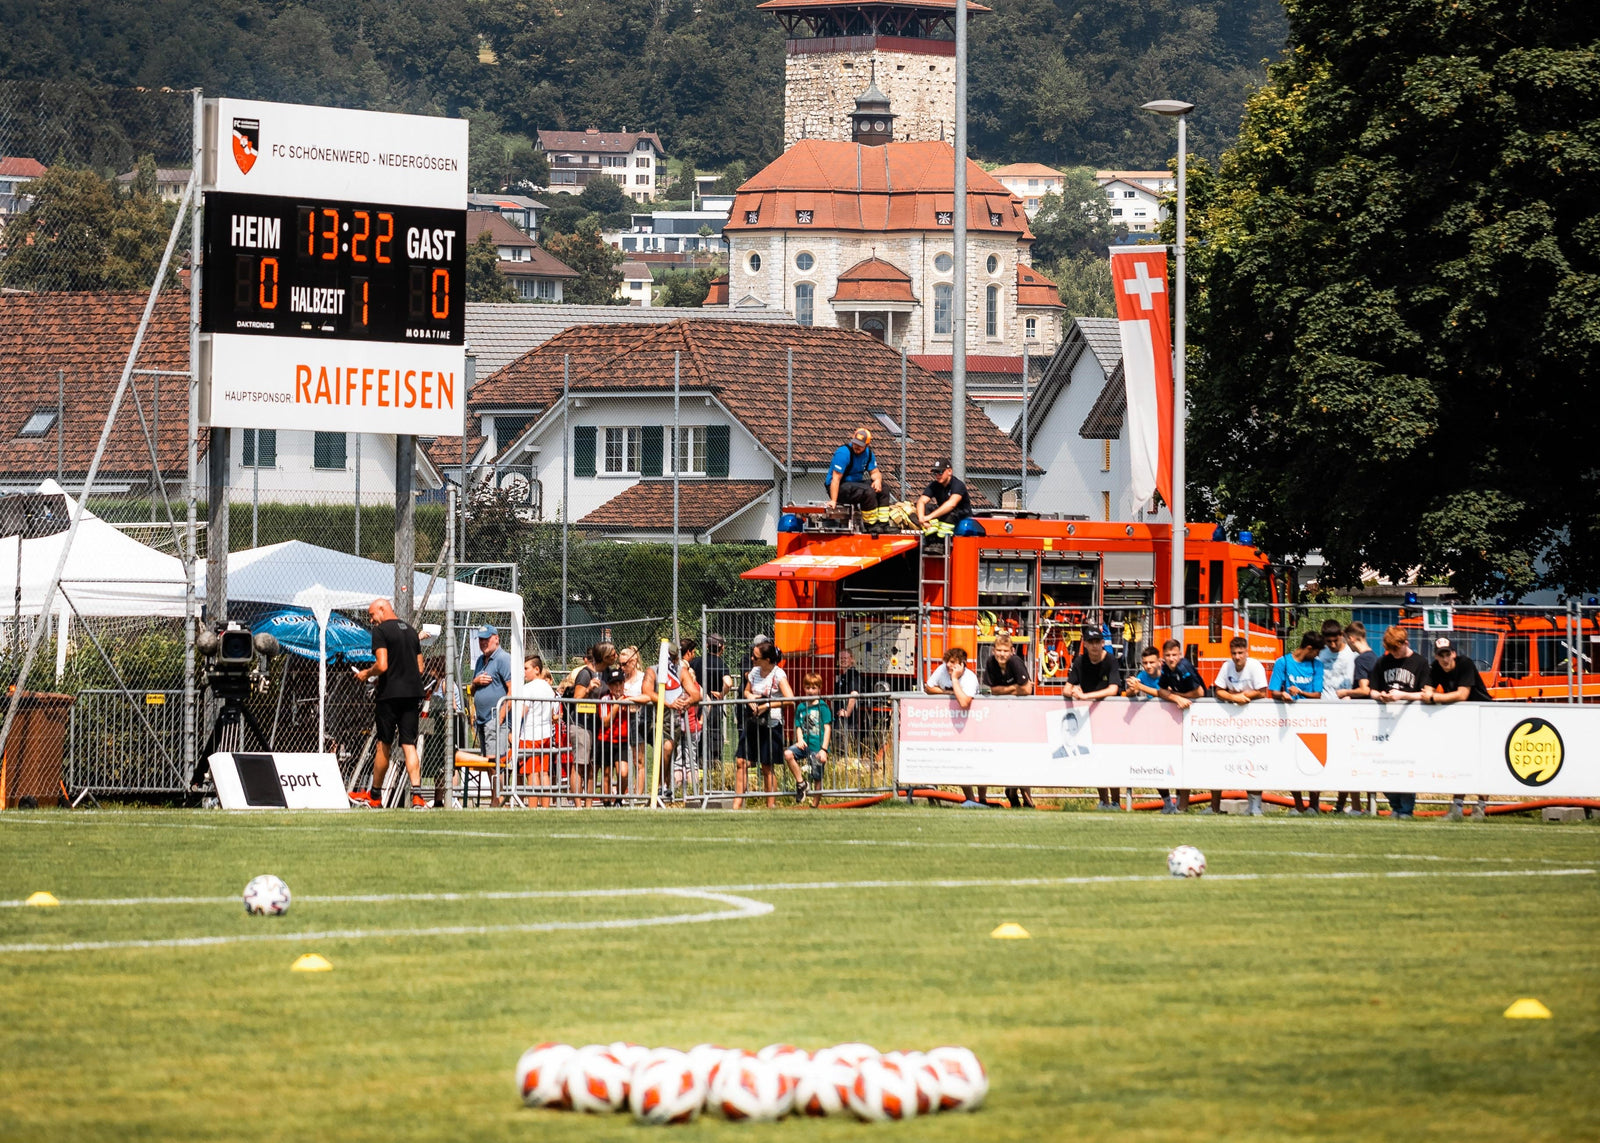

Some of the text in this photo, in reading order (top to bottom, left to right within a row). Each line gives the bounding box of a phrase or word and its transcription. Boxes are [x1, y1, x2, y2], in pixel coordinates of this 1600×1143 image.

[272, 144, 286, 158] FC
[289, 145, 370, 165] SCHÖNENWERD
[378, 153, 458, 172] NIEDERGÖSGEN
[231, 208, 456, 264] HEIM 13:22 GAST
[259, 257, 449, 326] 0 HALBZEIT 1 0
[236, 320, 451, 340] DAKTRONICS MOBATIME
[224, 364, 454, 410] HAUPTSPONSOR: RAIFFEISEN
[907, 705, 990, 721] Begeisterung?
[1191, 715, 1328, 730] Fernsehgenossenschaft
[1190, 732, 1270, 747] Niedergösgen
[1513, 740, 1556, 752] albani
[1514, 753, 1556, 767] sport
[1129, 766, 1165, 775] helvetia
[280, 772, 321, 792] sport
